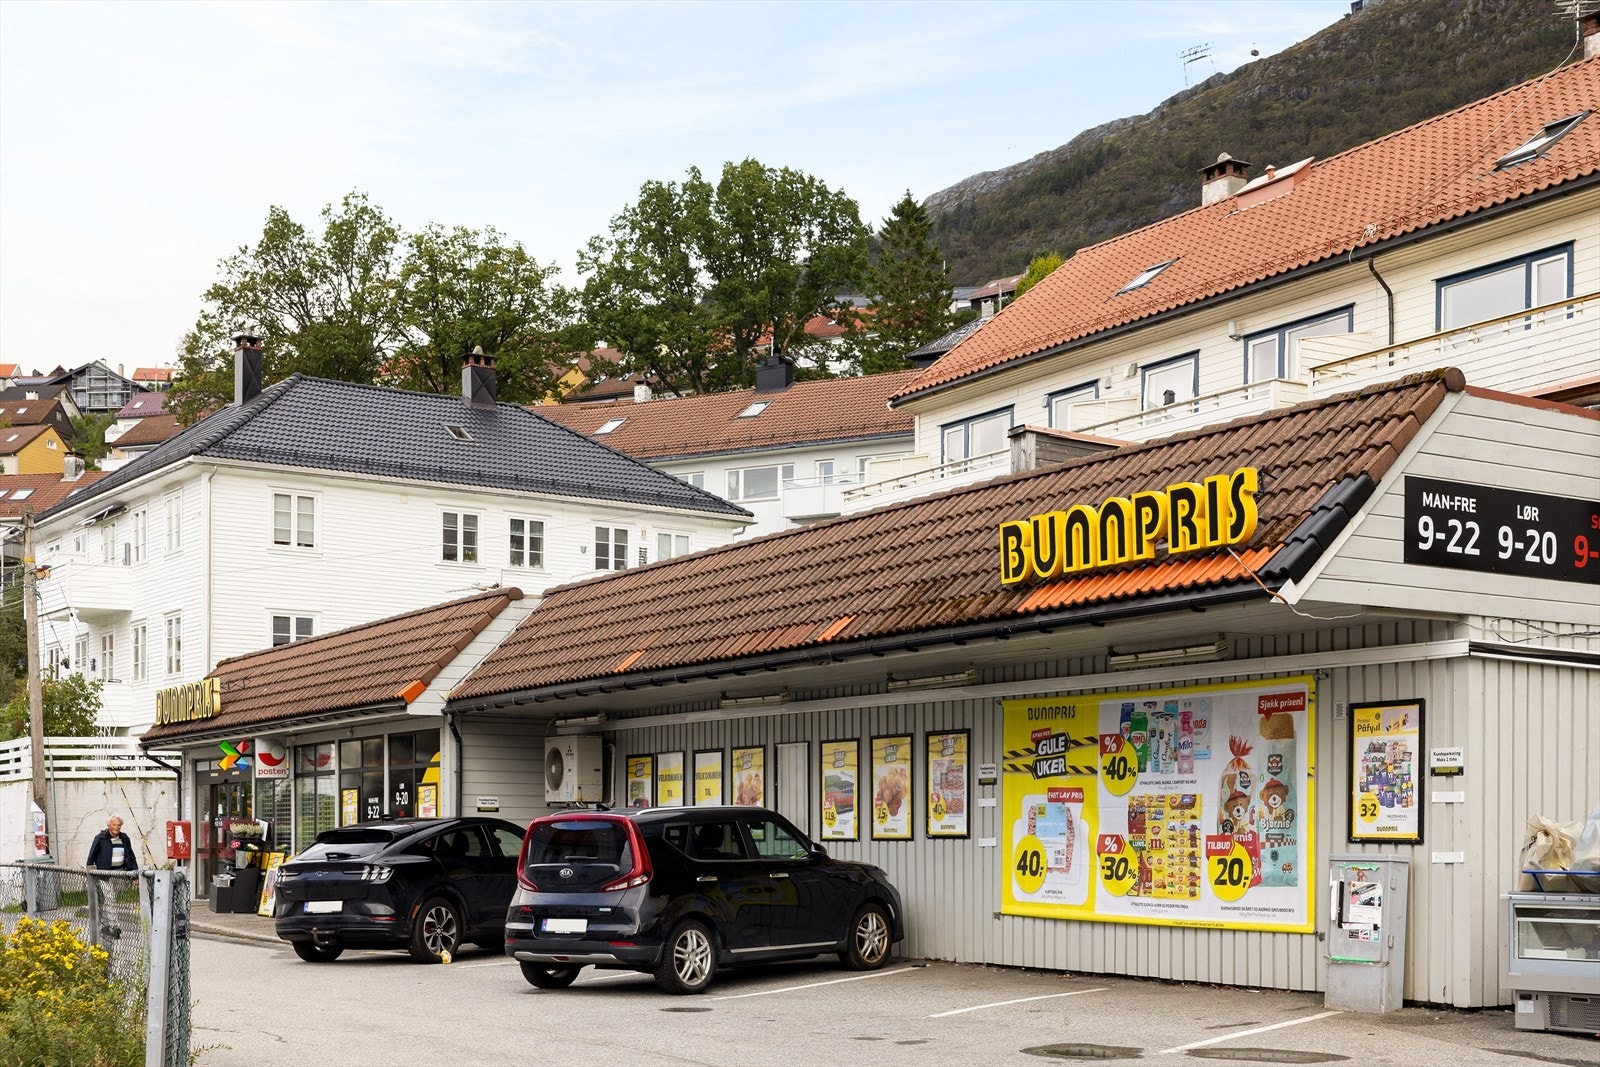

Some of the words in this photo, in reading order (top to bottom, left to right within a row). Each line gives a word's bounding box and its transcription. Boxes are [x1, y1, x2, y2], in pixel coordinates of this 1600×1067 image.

[1422, 491, 1477, 513] MAN-FRE
[1516, 504, 1540, 522] LØR
[1591, 514, 1600, 529] S
[1000, 467, 1258, 584] BUNNPRIS
[1417, 515, 1480, 556] 9-22
[1498, 525, 1558, 565] 9-20
[1573, 535, 1600, 568] 9-
[1028, 705, 1076, 720] BUNNPRIS
[1260, 700, 1279, 710] Sjekk
[1280, 697, 1304, 708] prisen!
[1038, 736, 1066, 756] GULE
[696, 771, 721, 780] VELKOMMEN
[1036, 758, 1066, 776] UKER
[1102, 756, 1136, 780] -40%
[658, 773, 683, 782] VELKOMMEN
[396, 792, 408, 805] 9-20
[368, 806, 380, 819] 9-22
[1260, 819, 1291, 832] Bjørnis
[1207, 841, 1231, 850] TILBUD
[1101, 856, 1137, 881] -30%
[1214, 857, 1249, 888] 20,-
